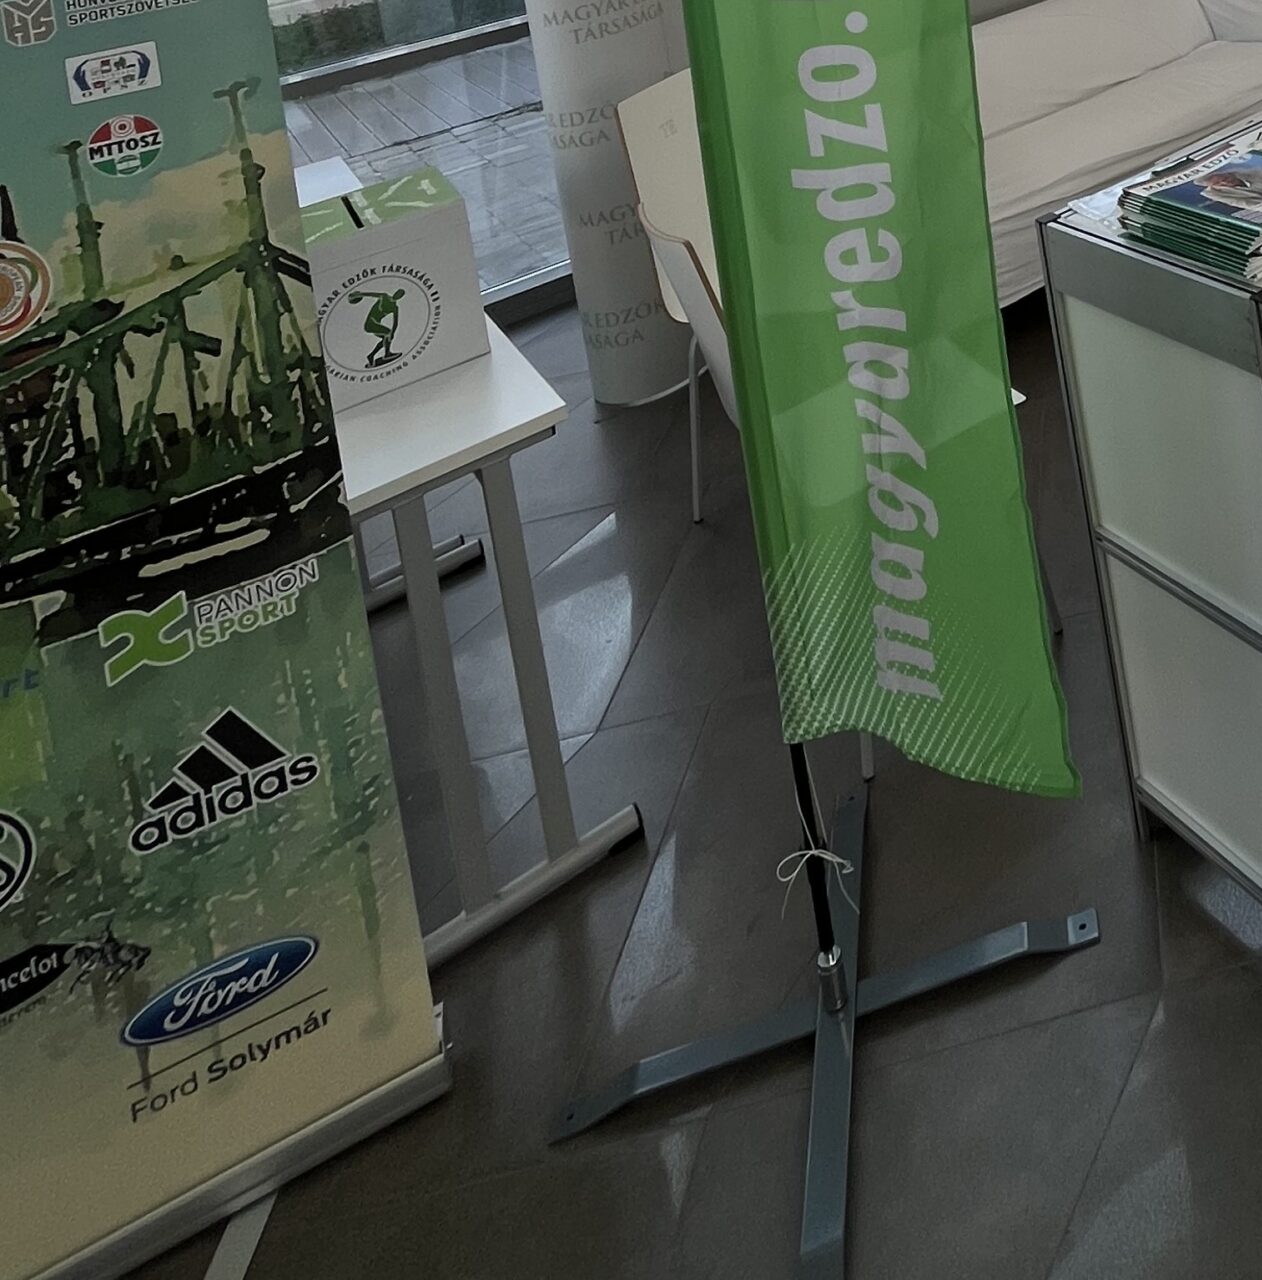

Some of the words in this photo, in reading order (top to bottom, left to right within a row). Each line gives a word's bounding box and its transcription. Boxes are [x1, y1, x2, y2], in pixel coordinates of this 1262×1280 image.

[88, 131, 163, 161] MTTOSZ
[196, 560, 319, 624] PANNON
[197, 590, 300, 648] SPORT
[130, 755, 319, 852] adidas
[163, 952, 280, 1031] Ford
[130, 1072, 199, 1123] Ford
[207, 1008, 332, 1085] Solymár
